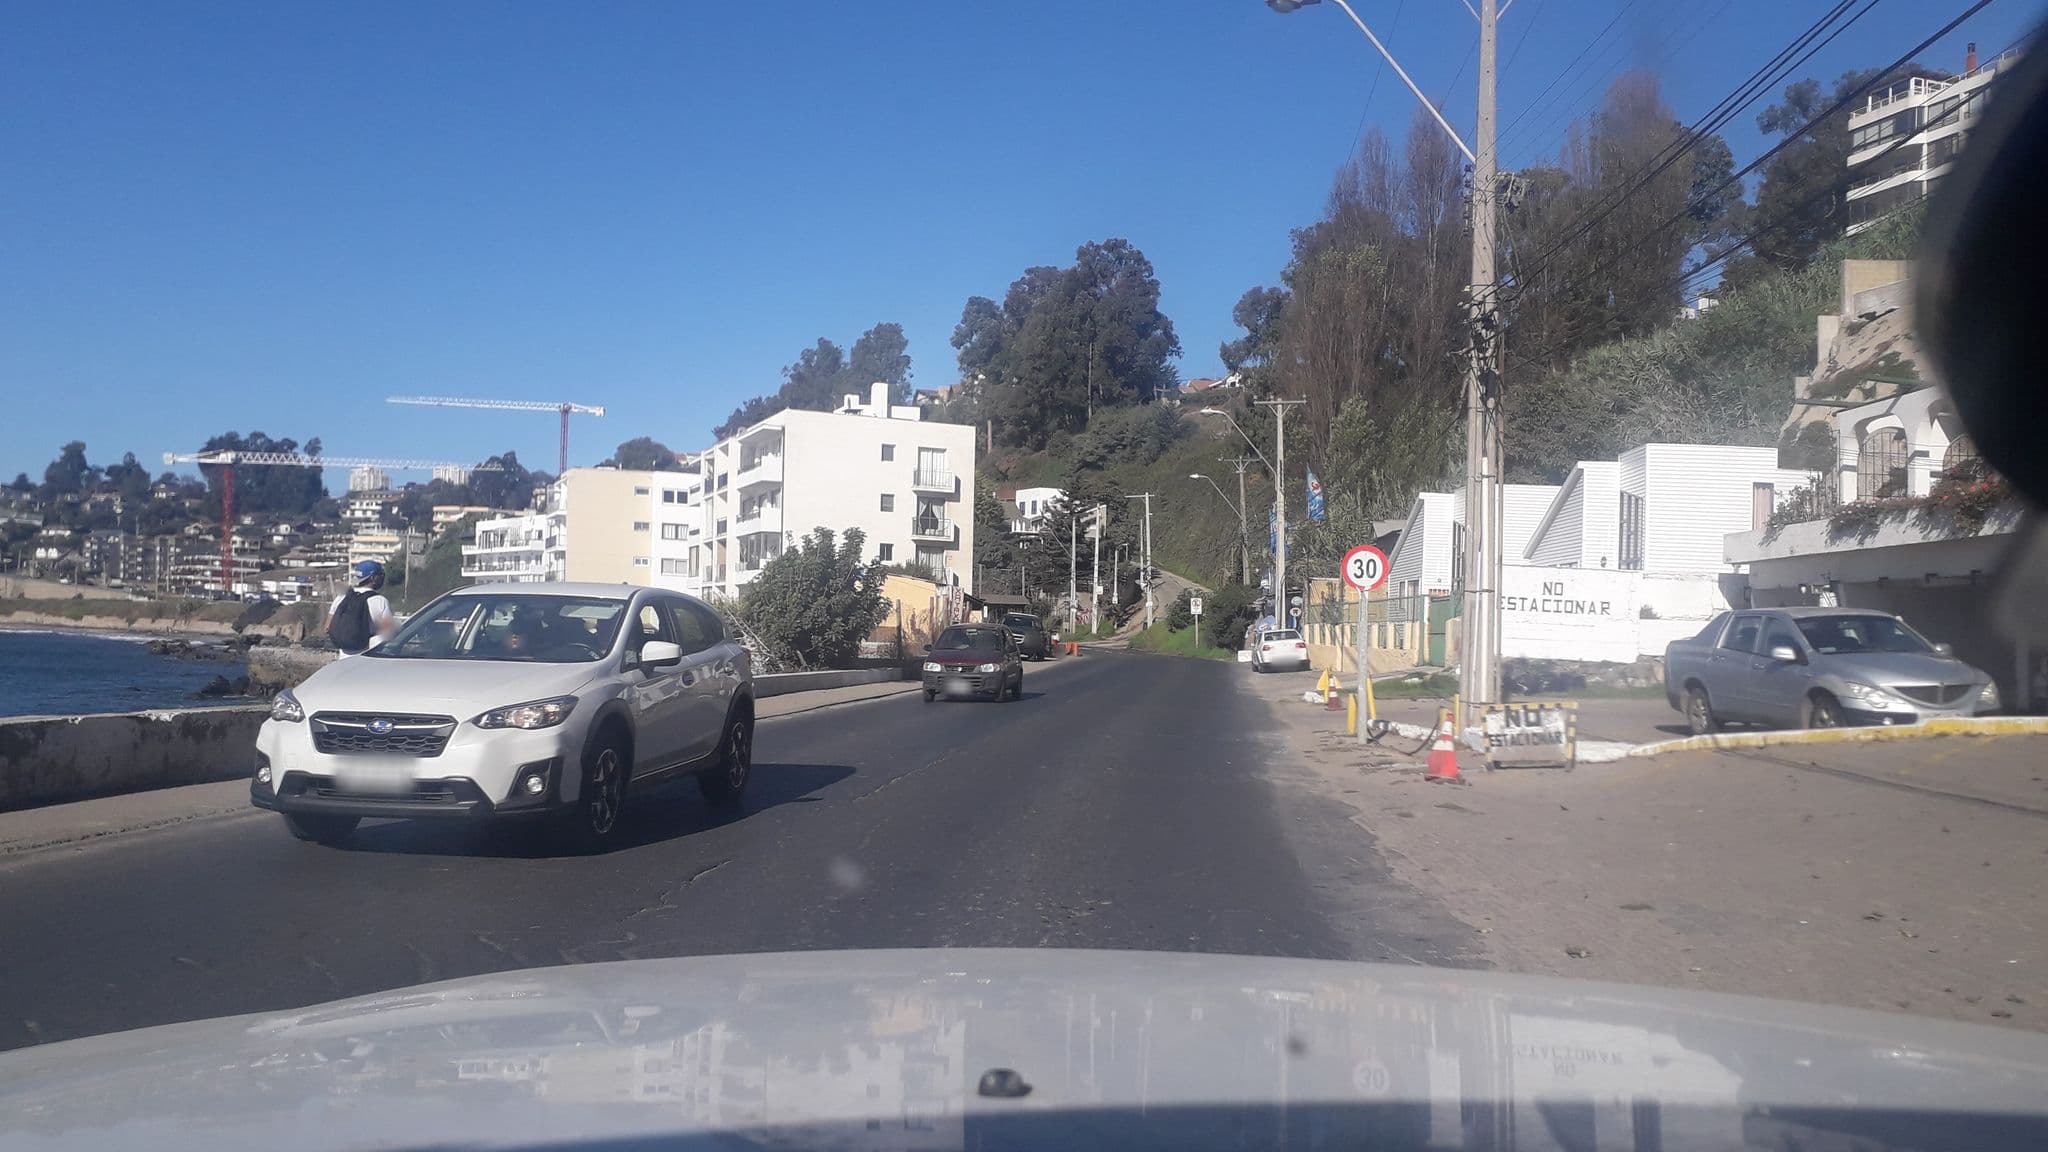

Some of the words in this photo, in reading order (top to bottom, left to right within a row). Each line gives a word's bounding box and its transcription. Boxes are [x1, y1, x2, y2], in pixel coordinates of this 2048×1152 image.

[1353, 558, 1377, 579] 30
[1542, 582, 1564, 596] NO
[1504, 706, 1542, 728] NO
